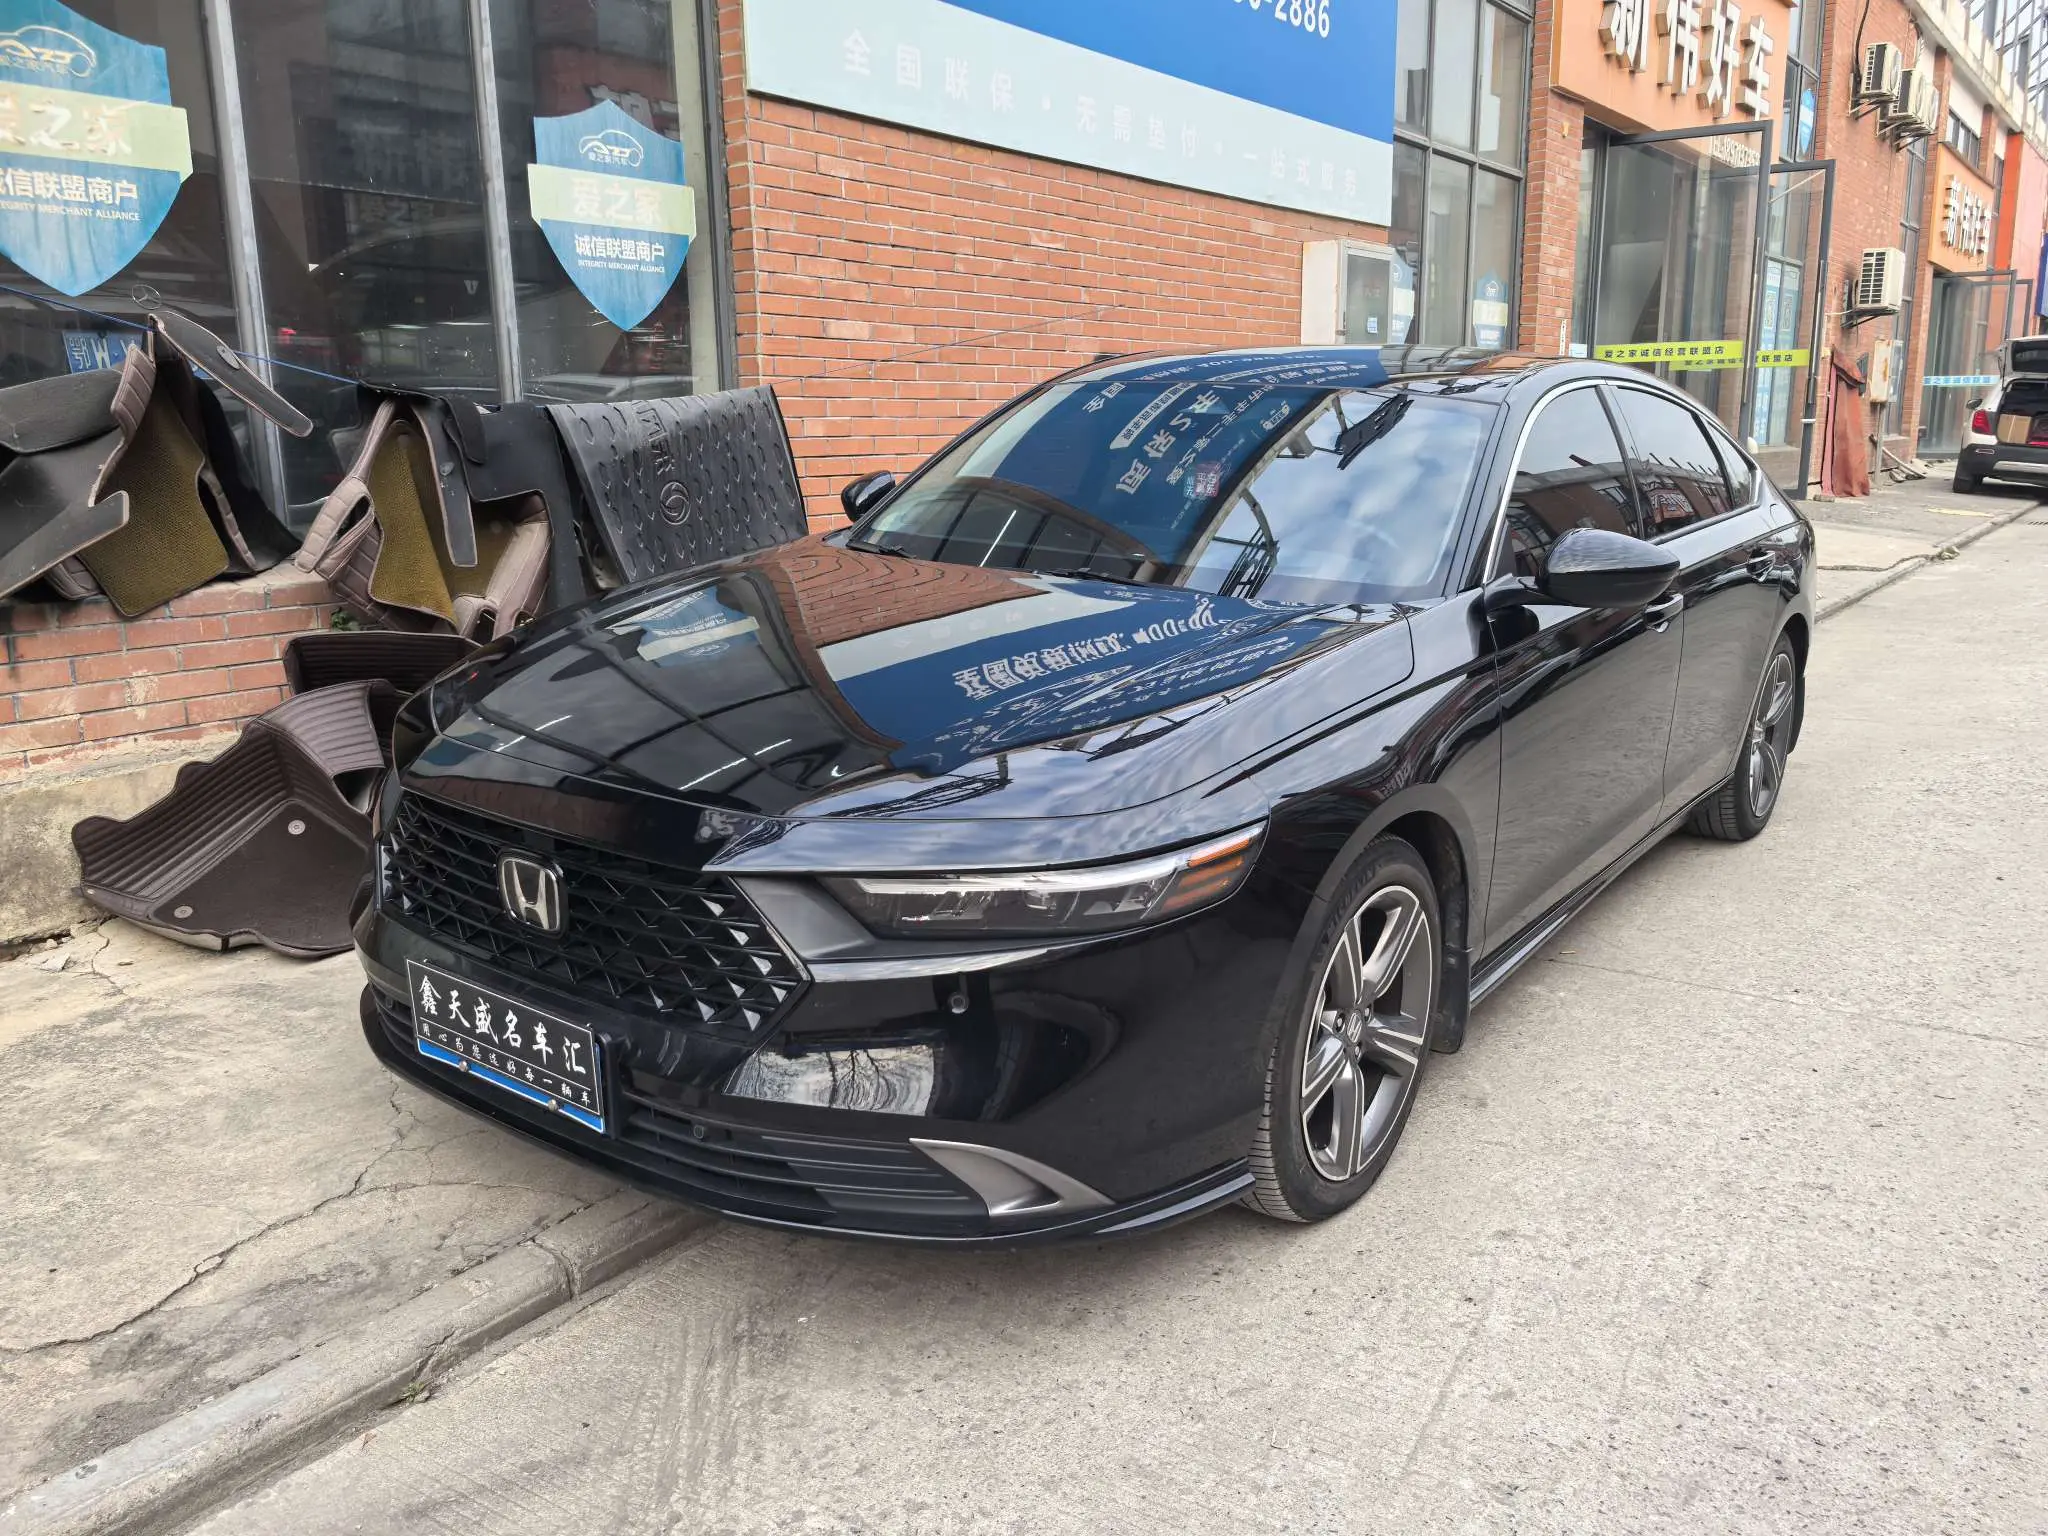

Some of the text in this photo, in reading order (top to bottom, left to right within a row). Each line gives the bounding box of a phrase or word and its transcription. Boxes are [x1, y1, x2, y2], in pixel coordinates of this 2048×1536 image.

[0, 167, 139, 206] 信联盟商户
[38, 203, 94, 217] MERCHANT
[96, 207, 141, 221] ALLIANCE
[575, 235, 665, 262] 诚信联盟商户
[608, 261, 639, 272] MERCHANT
[640, 263, 665, 273] ALLIANCE
[1604, 345, 1724, 359] 爱之家诚信经营联盟店
[419, 975, 587, 1075] 鑫天盛名车汇
[422, 1022, 591, 1107] 用心为您选好每一辆车
